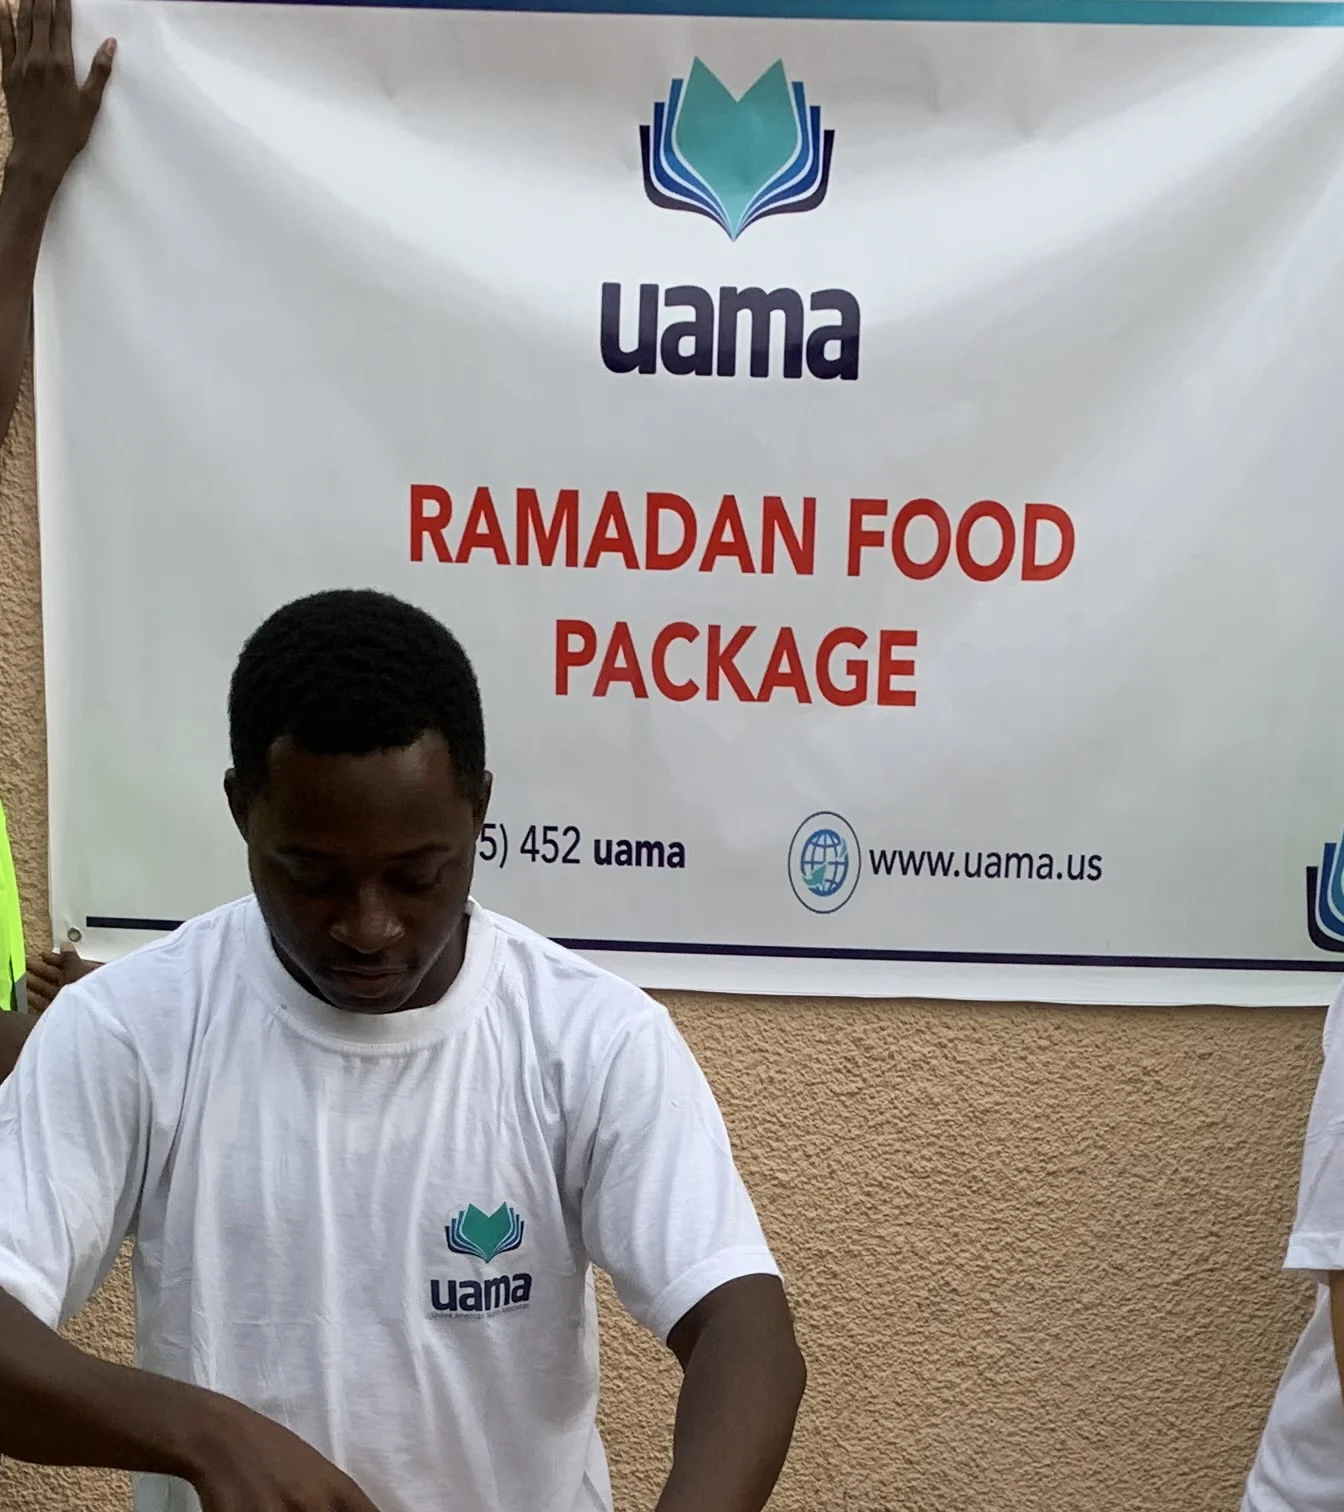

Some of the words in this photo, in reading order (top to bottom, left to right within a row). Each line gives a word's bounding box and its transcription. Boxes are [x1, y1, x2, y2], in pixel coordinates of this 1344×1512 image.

[601, 282, 860, 380] uama
[409, 484, 816, 576] RAMADAN
[847, 498, 1075, 582] FOOD
[555, 619, 918, 707] PACKAGE
[479, 823, 508, 869] 5)
[520, 825, 581, 867] 452
[592, 834, 686, 869] uama
[869, 845, 1103, 882] www.uama.us
[430, 1272, 533, 1312] uama
